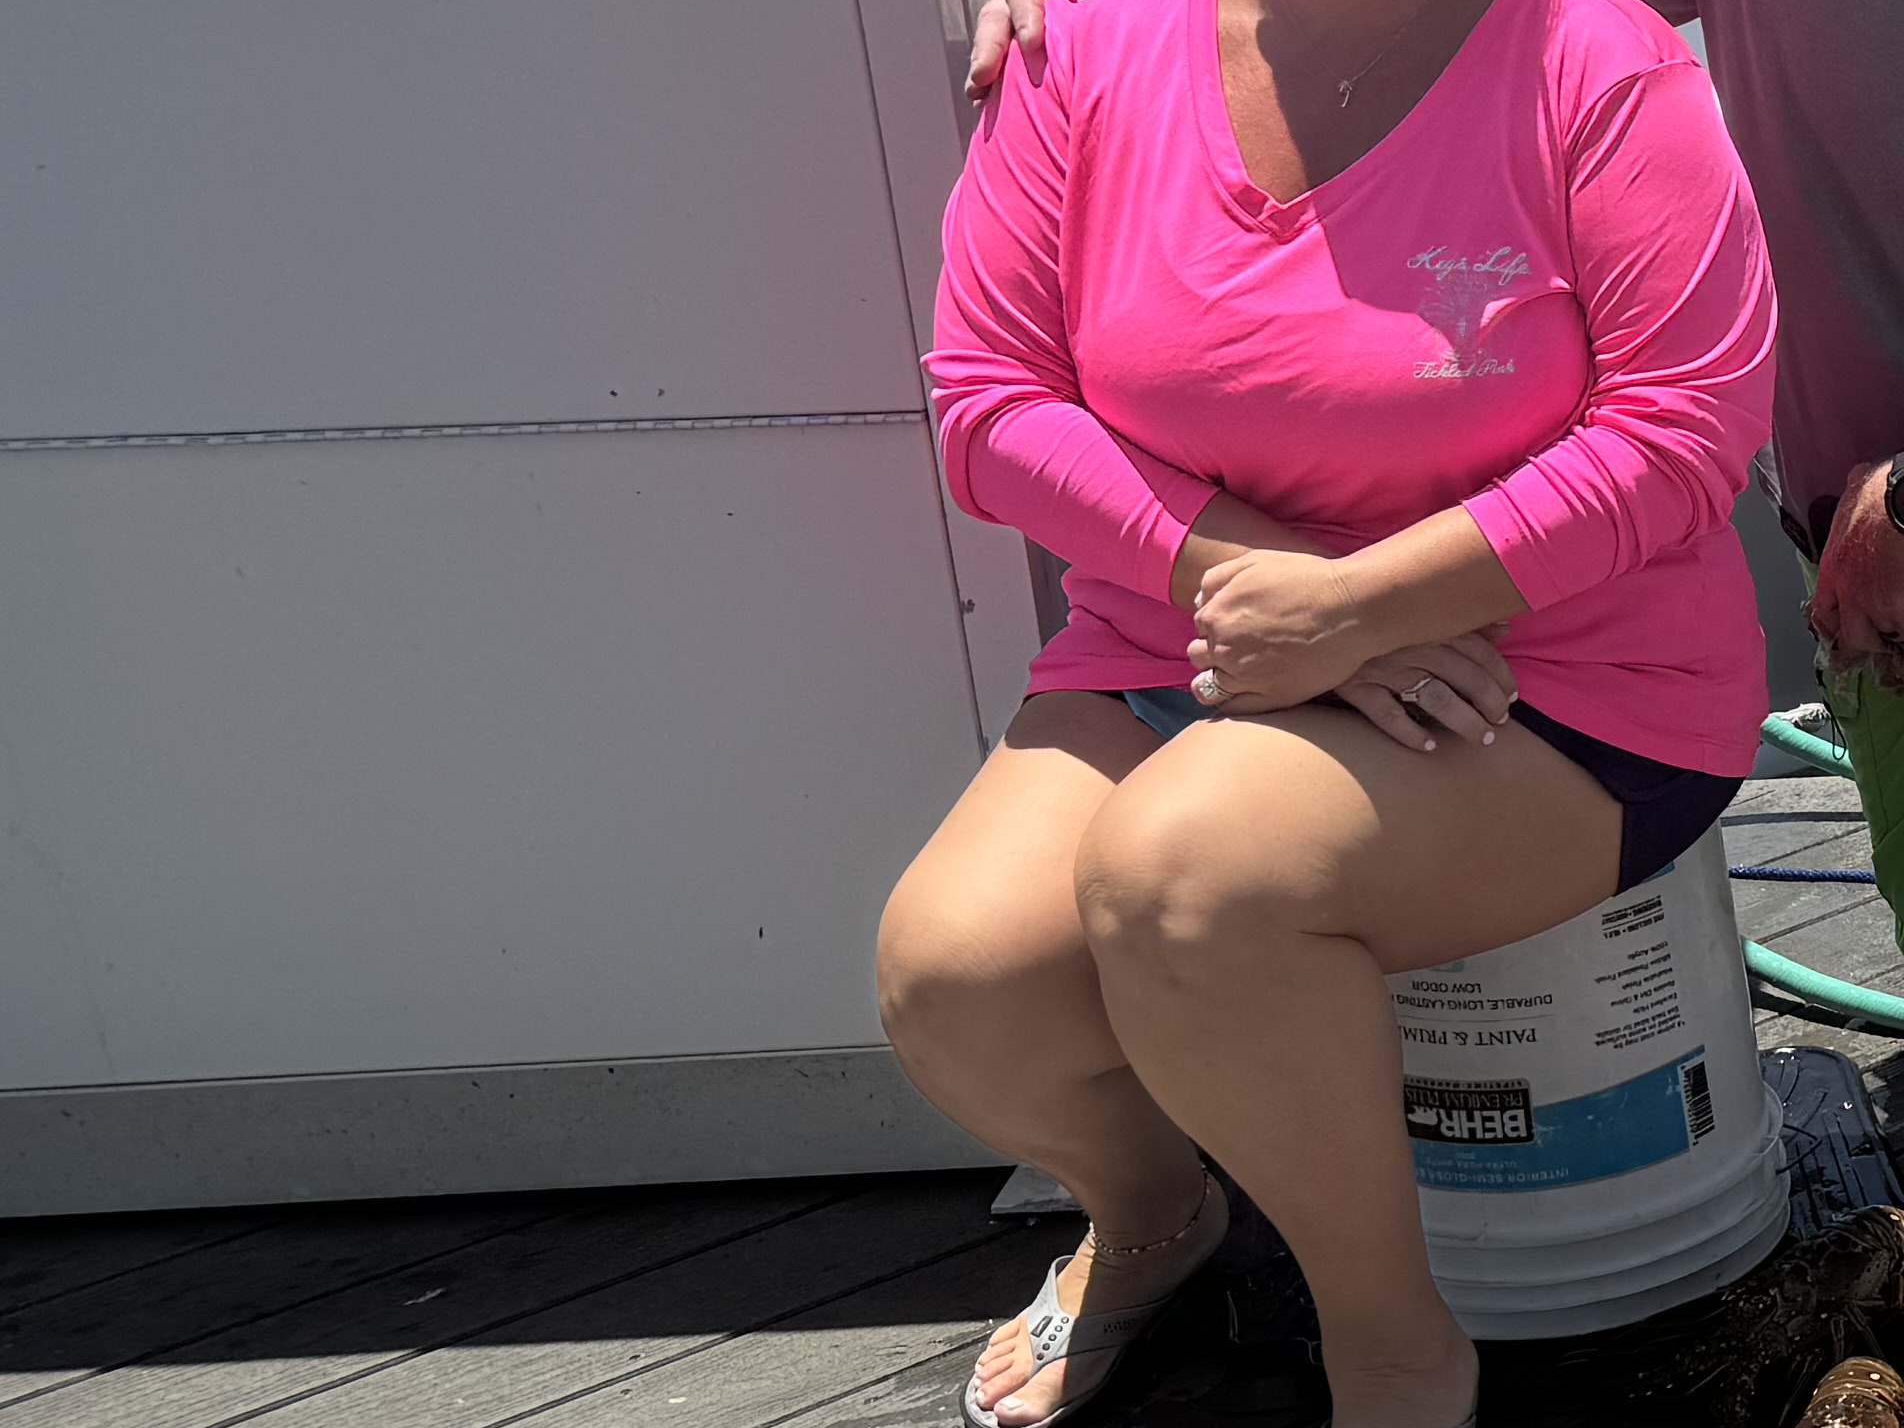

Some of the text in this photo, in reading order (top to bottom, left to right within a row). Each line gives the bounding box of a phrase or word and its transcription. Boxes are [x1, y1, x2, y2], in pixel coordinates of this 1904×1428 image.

[1472, 246, 1532, 286] Life
[1412, 980, 1482, 994] LOW ODOR
[1397, 994, 1553, 1011] DURABLE, LONG-LASTING
[1398, 1025, 1537, 1047] PAINT & PRIM
[1405, 1088, 1524, 1109] PREMIUM PLUS
[1438, 1108, 1528, 1140] BEHR
[1506, 1167, 1569, 1184] INTERIOR
